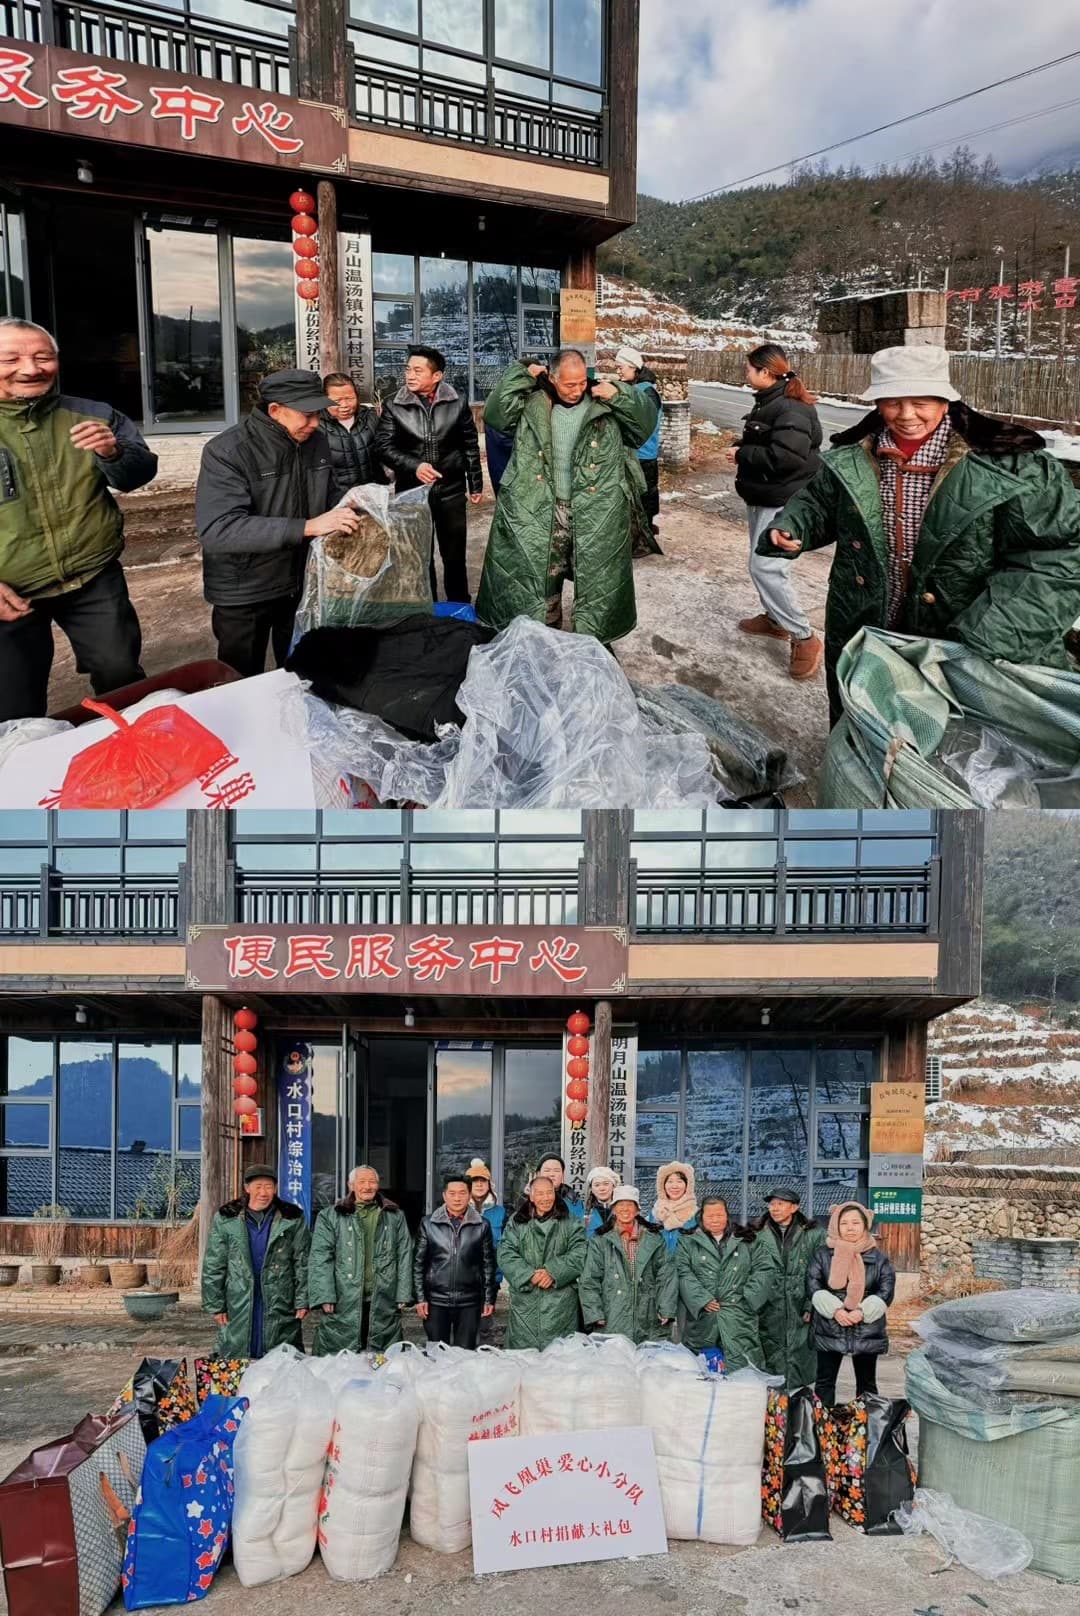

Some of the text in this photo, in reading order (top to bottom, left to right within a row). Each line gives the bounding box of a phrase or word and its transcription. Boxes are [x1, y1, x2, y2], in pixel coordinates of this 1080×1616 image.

[224, 934, 587, 984] 便民服务中心
[510, 1519, 633, 1548] 水口村捐献大礼包
